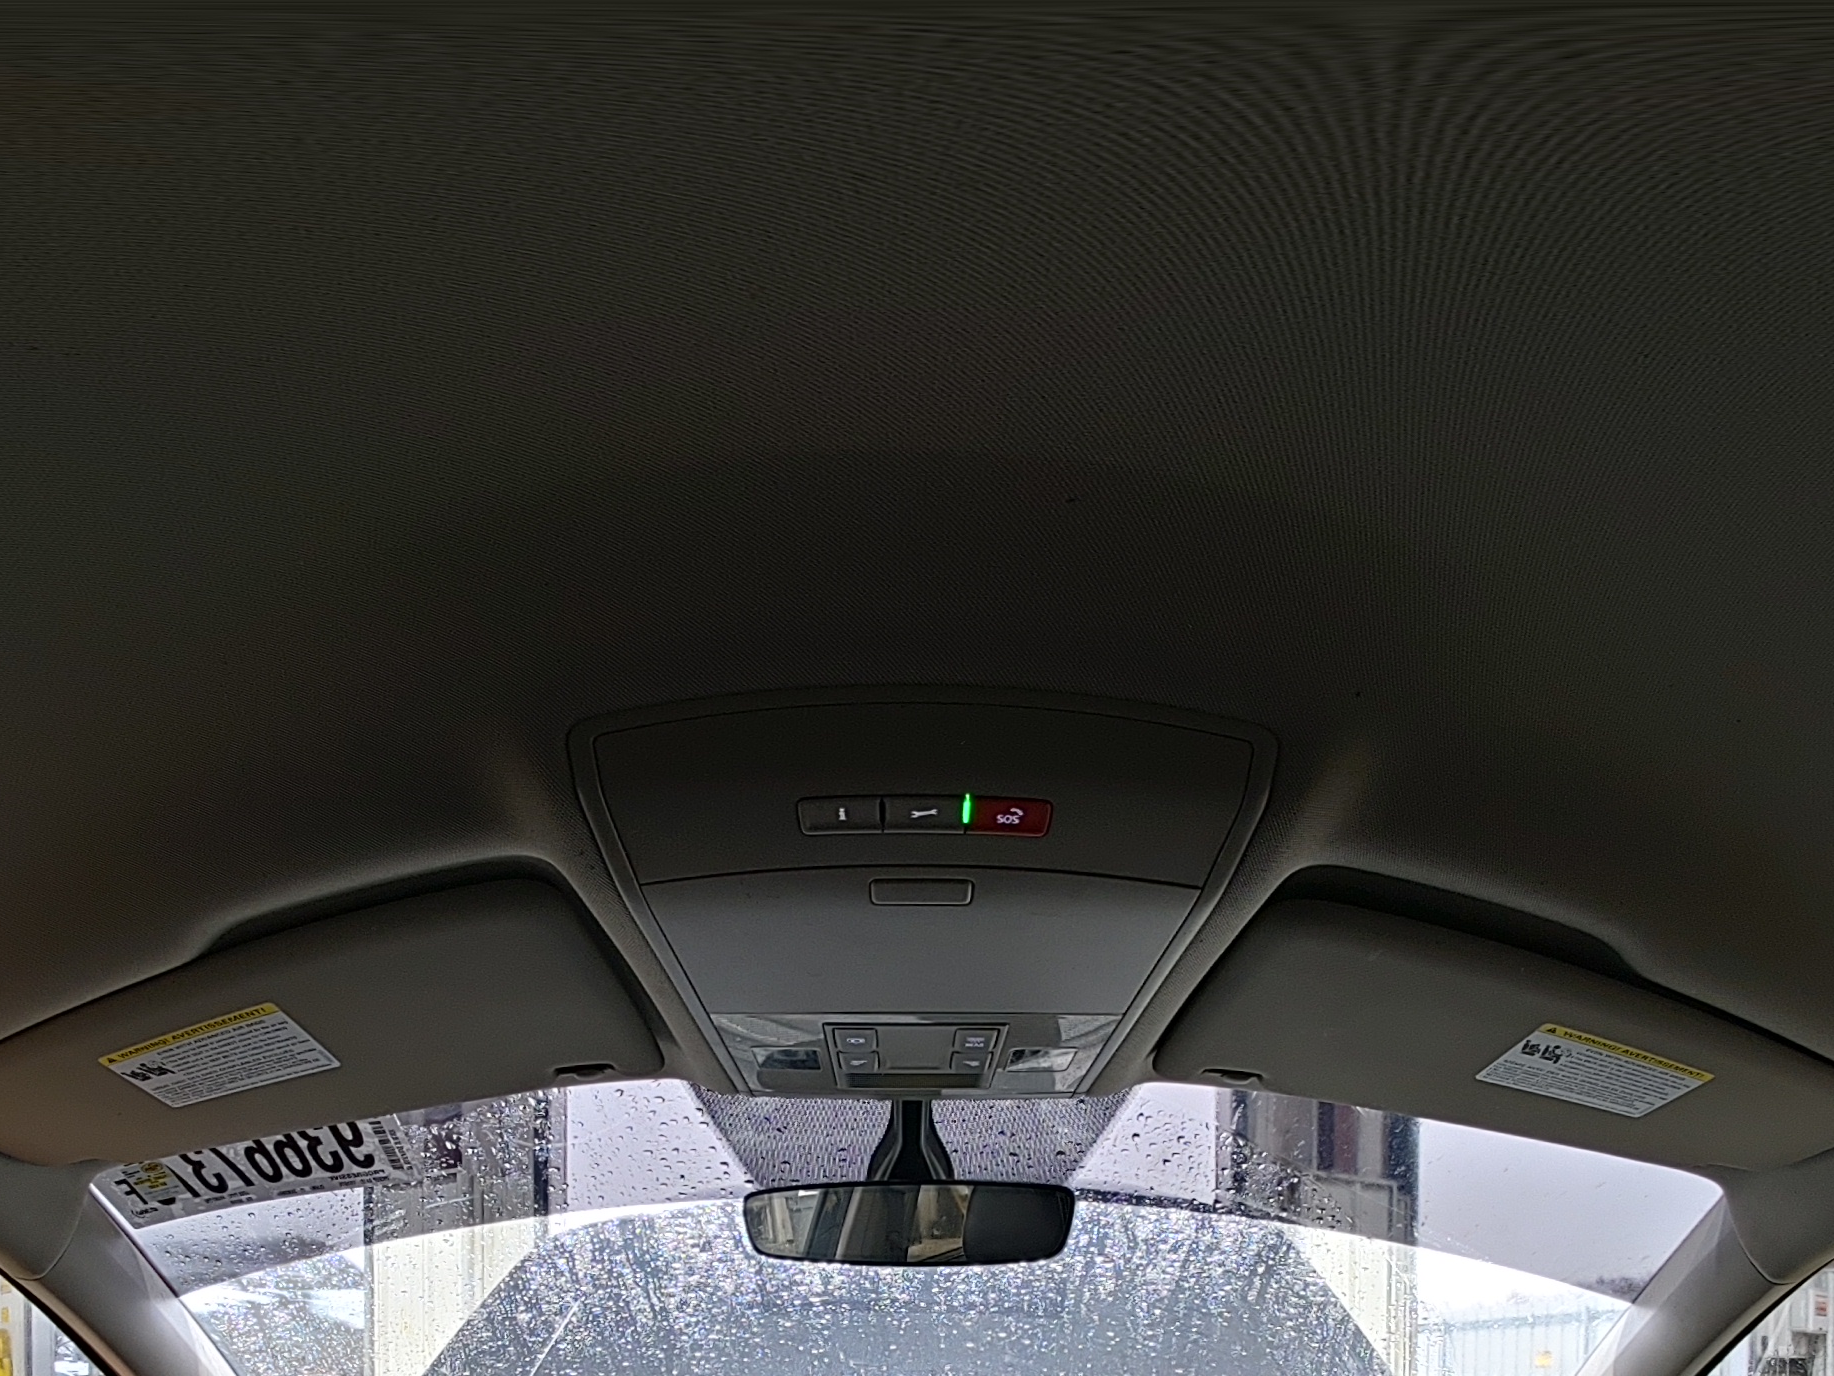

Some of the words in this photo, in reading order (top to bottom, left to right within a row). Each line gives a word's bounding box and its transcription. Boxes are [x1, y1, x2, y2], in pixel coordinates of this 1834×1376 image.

[996, 814, 1020, 824] SOS
[118, 1038, 169, 1058] WARNING!
[172, 1007, 266, 1041] AVERTISSEMENT!
[1563, 1030, 1621, 1052] WARNING!
